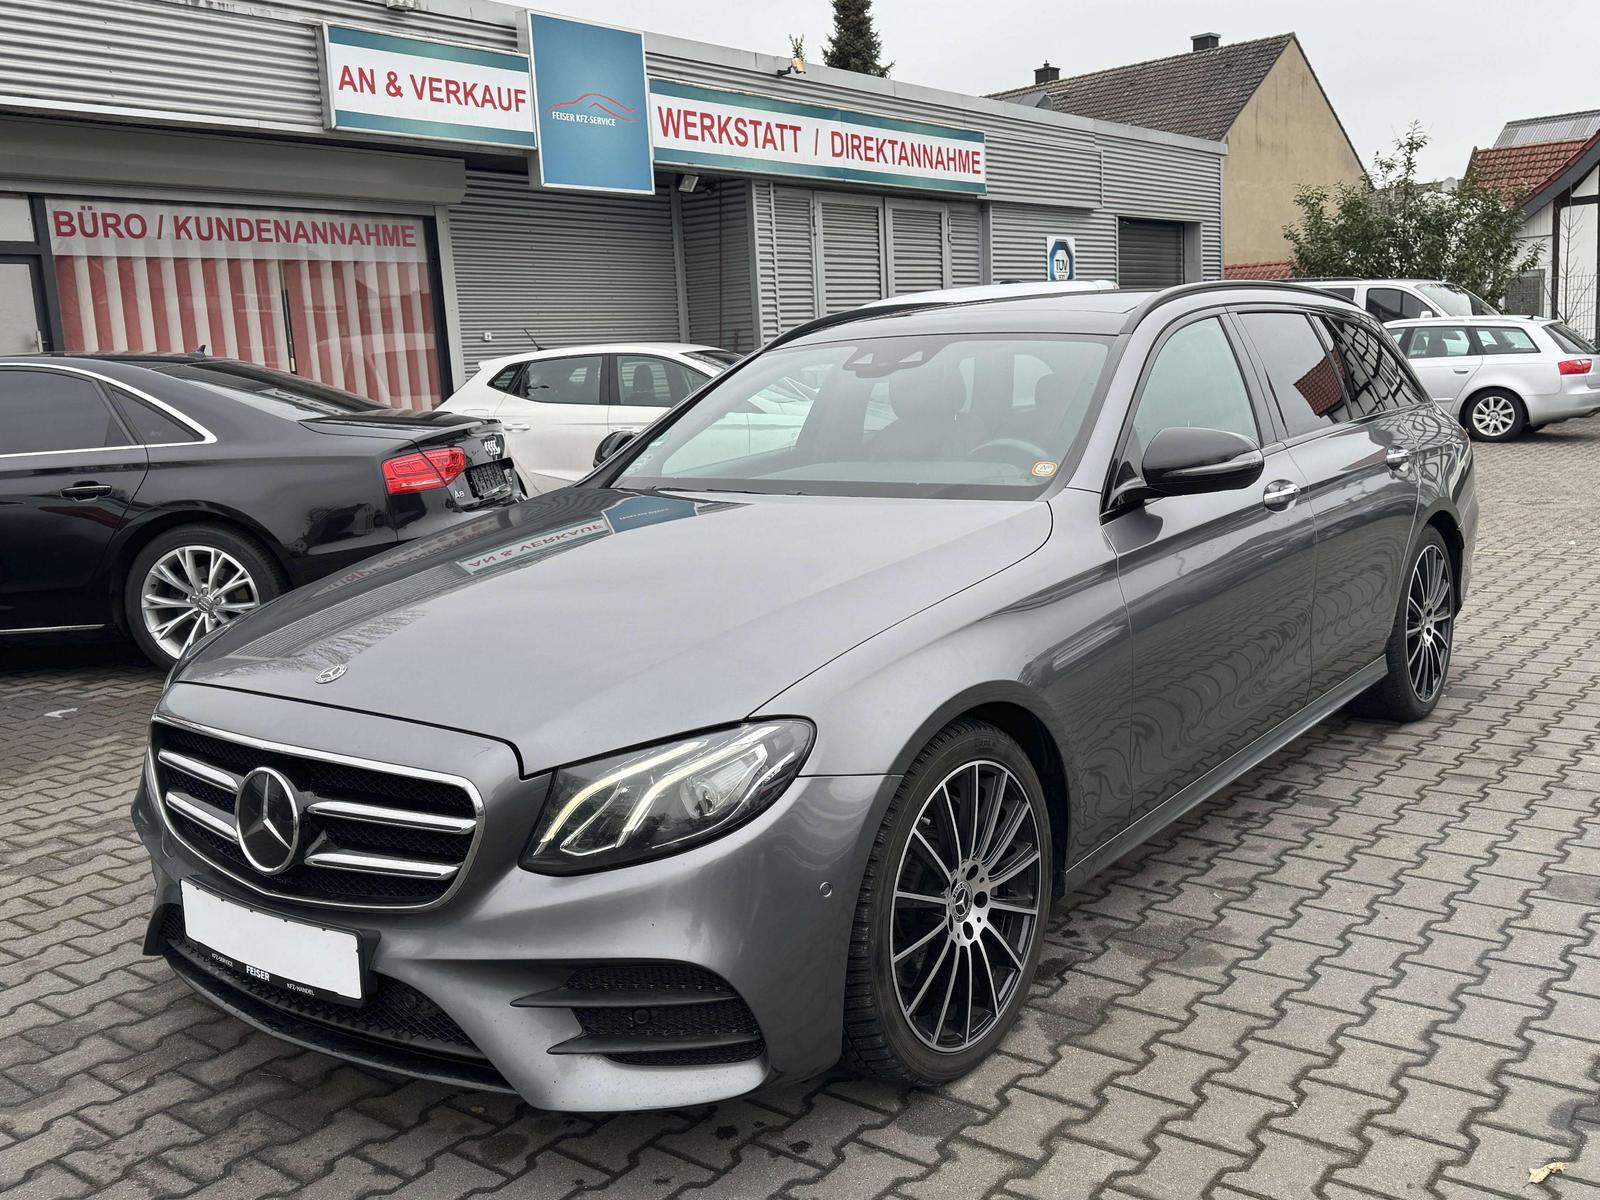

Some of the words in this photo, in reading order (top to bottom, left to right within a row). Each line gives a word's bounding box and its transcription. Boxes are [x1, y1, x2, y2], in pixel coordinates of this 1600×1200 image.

[338, 65, 376, 95] AN
[385, 71, 403, 98] &
[409, 74, 526, 112] VERKAUF
[552, 111, 575, 122] FEISER
[576, 113, 616, 127] KFZ-SERVICE
[657, 106, 801, 153] WERKSTATT
[814, 128, 819, 156] /
[830, 131, 981, 174] DIREKTANNAHME
[53, 205, 147, 239] BÜRO
[157, 214, 163, 240] /
[173, 215, 417, 247] KUNDENANNAHME
[246, 965, 270, 981] FEISER
[286, 983, 315, 996] KFZ-HANDEL
